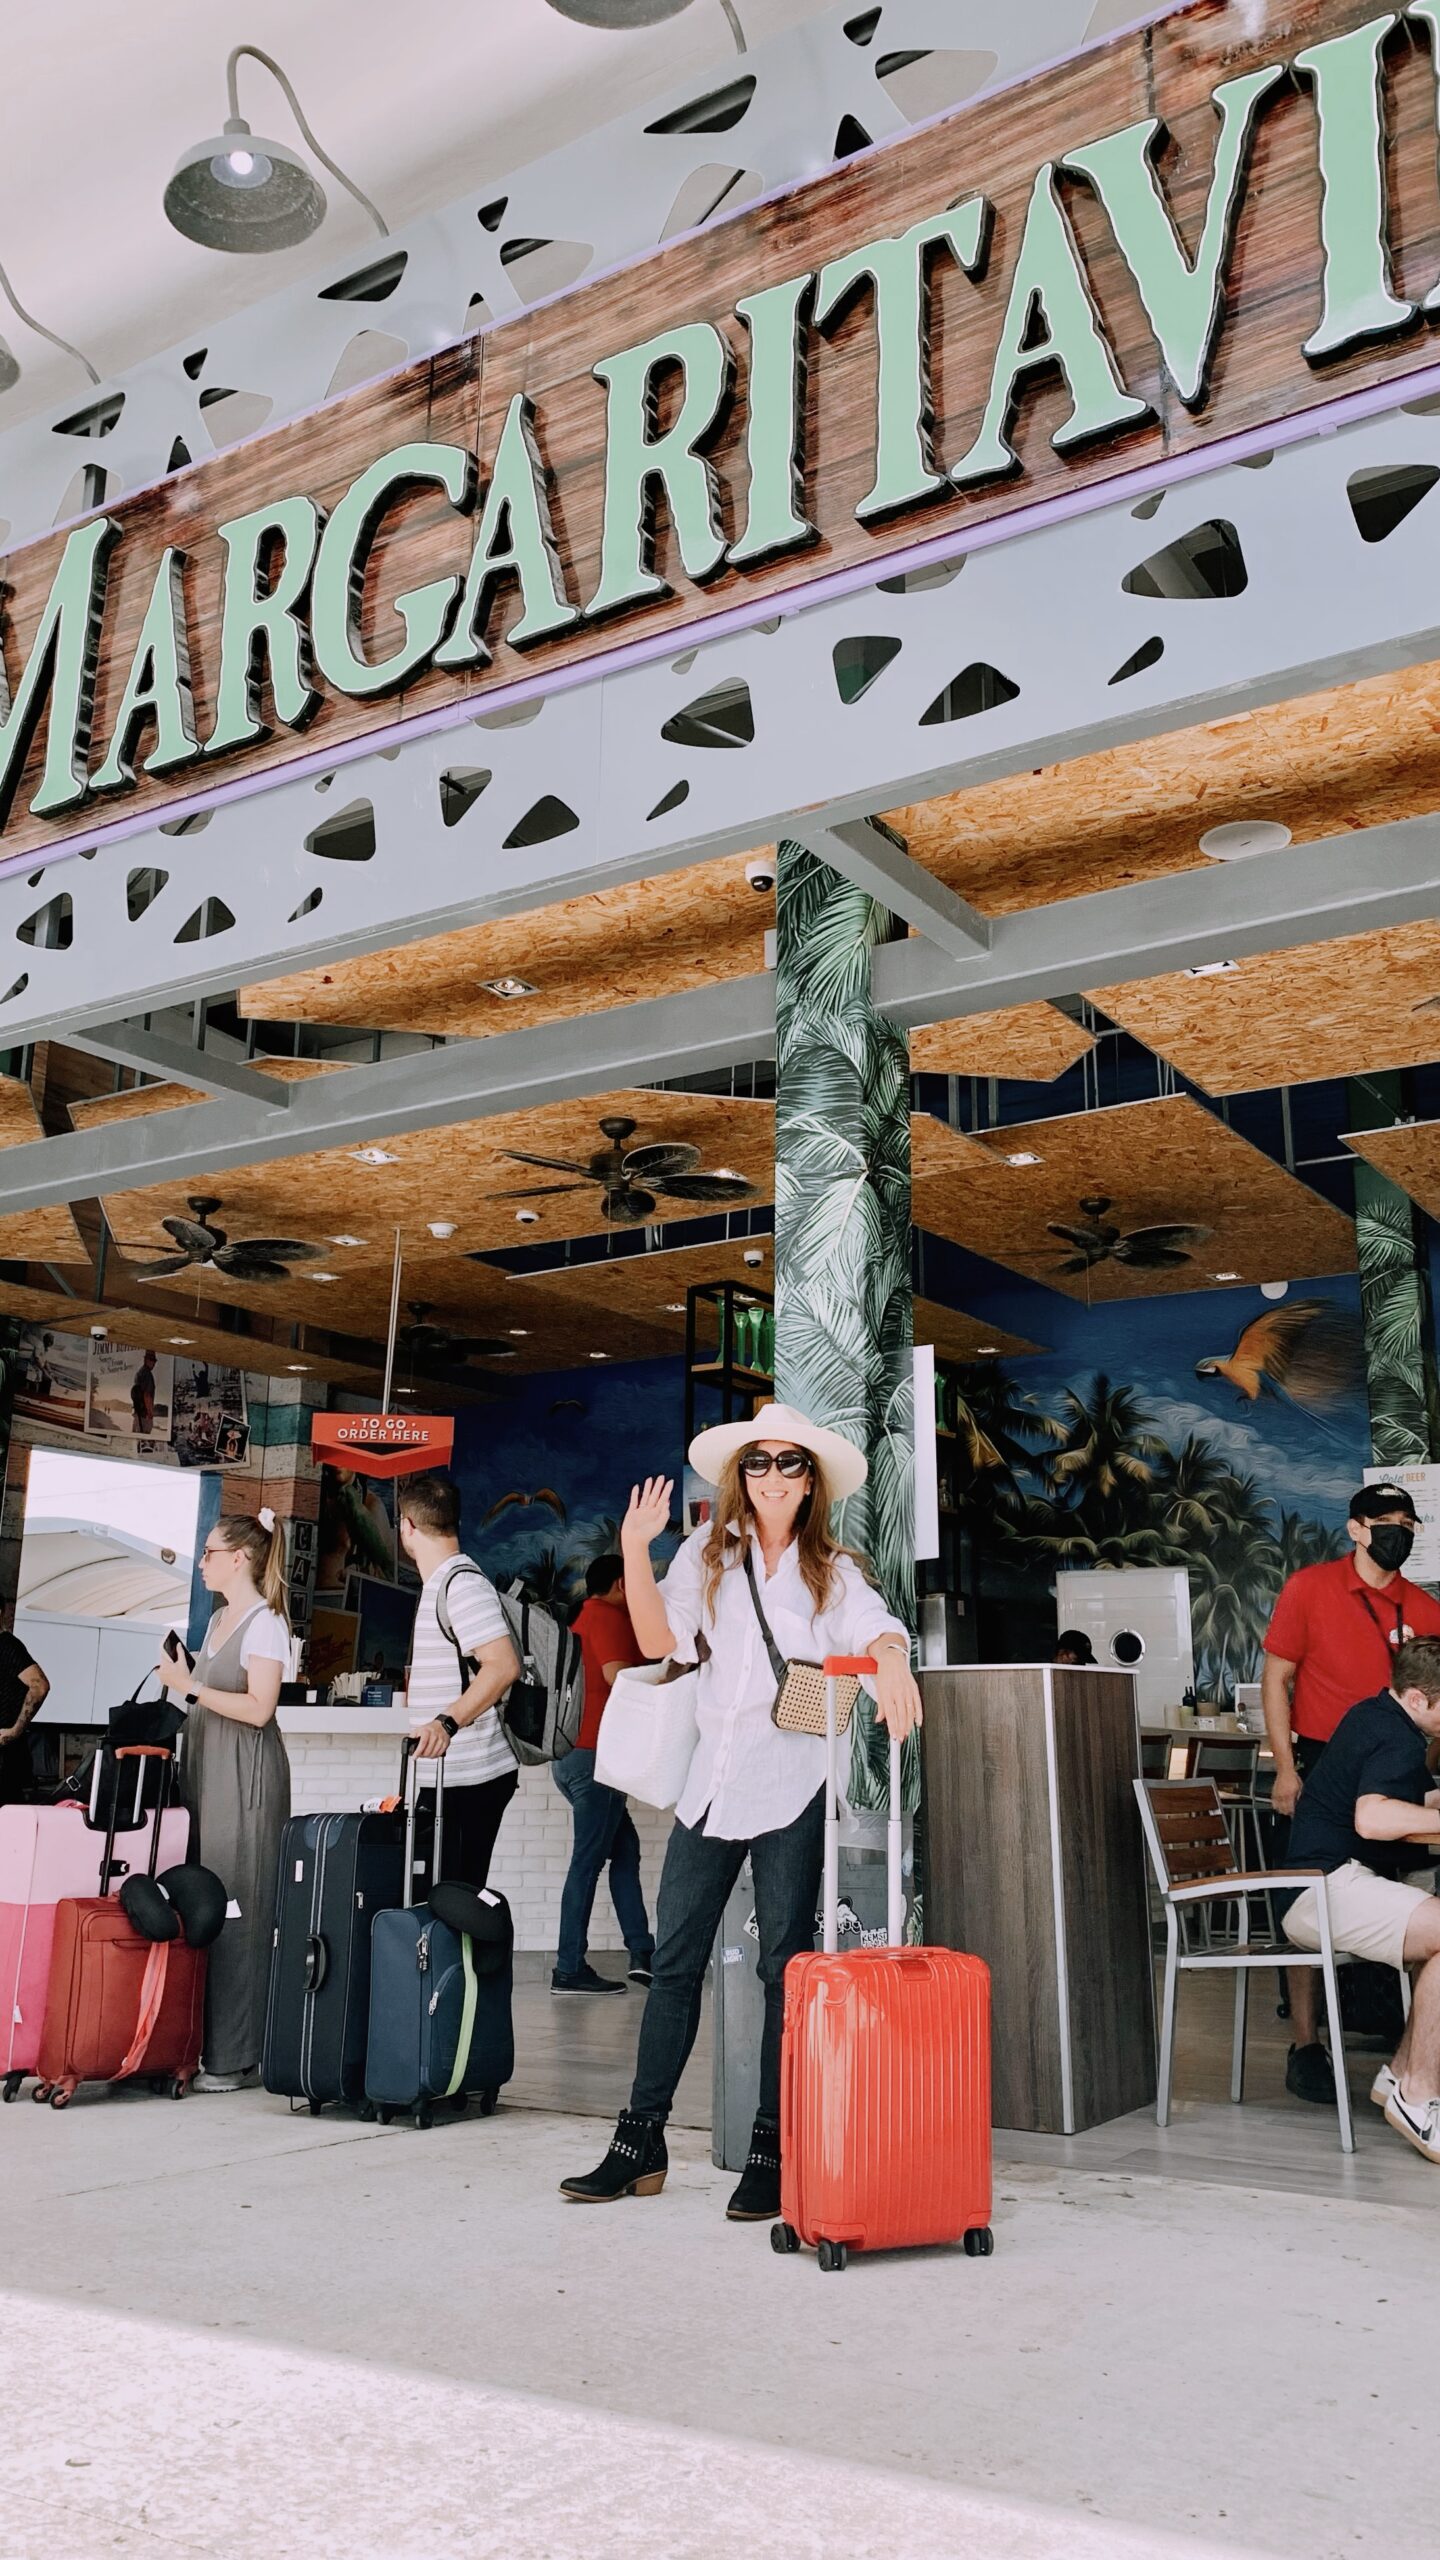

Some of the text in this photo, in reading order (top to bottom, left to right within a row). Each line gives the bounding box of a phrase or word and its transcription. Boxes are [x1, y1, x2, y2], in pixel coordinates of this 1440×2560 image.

[0, 0, 1440, 830] MARGARITAVI
[361, 1418, 407, 1430] TO GO
[337, 1428, 430, 1441] ORDER HERE
